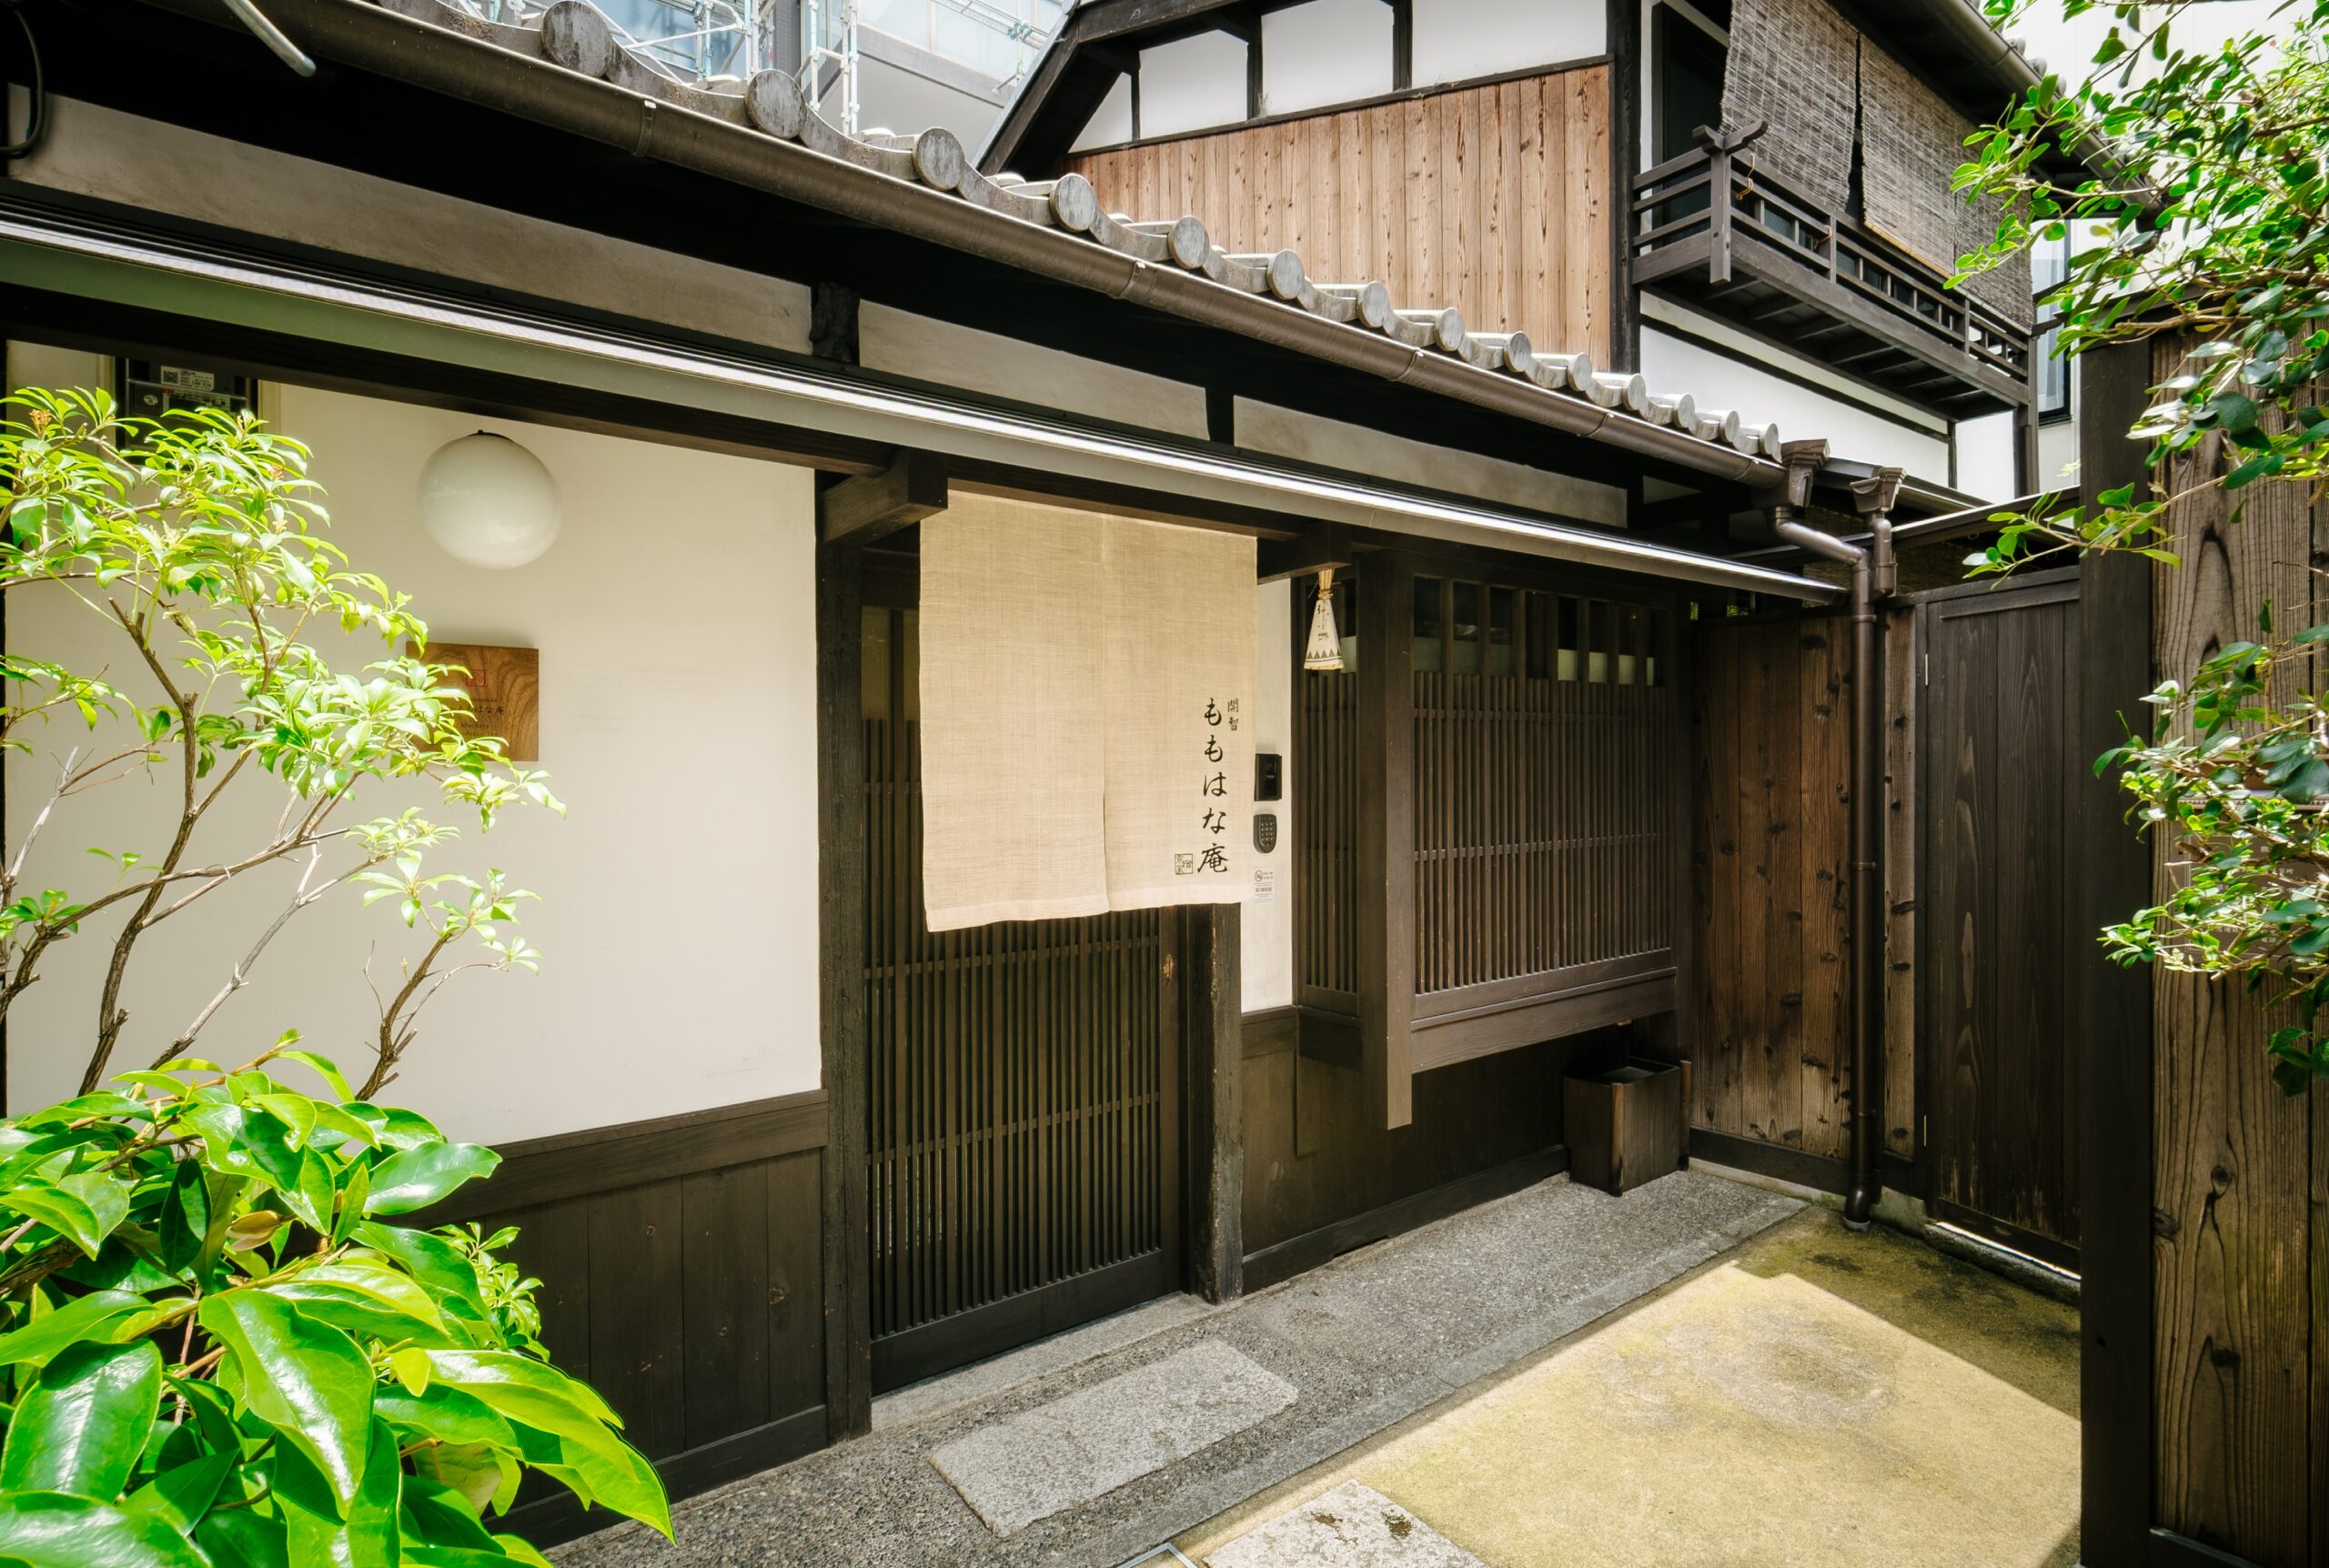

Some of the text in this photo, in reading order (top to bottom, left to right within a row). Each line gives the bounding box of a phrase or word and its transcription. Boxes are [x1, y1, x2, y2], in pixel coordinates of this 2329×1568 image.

[1197, 698, 1228, 873] ももはな庵
